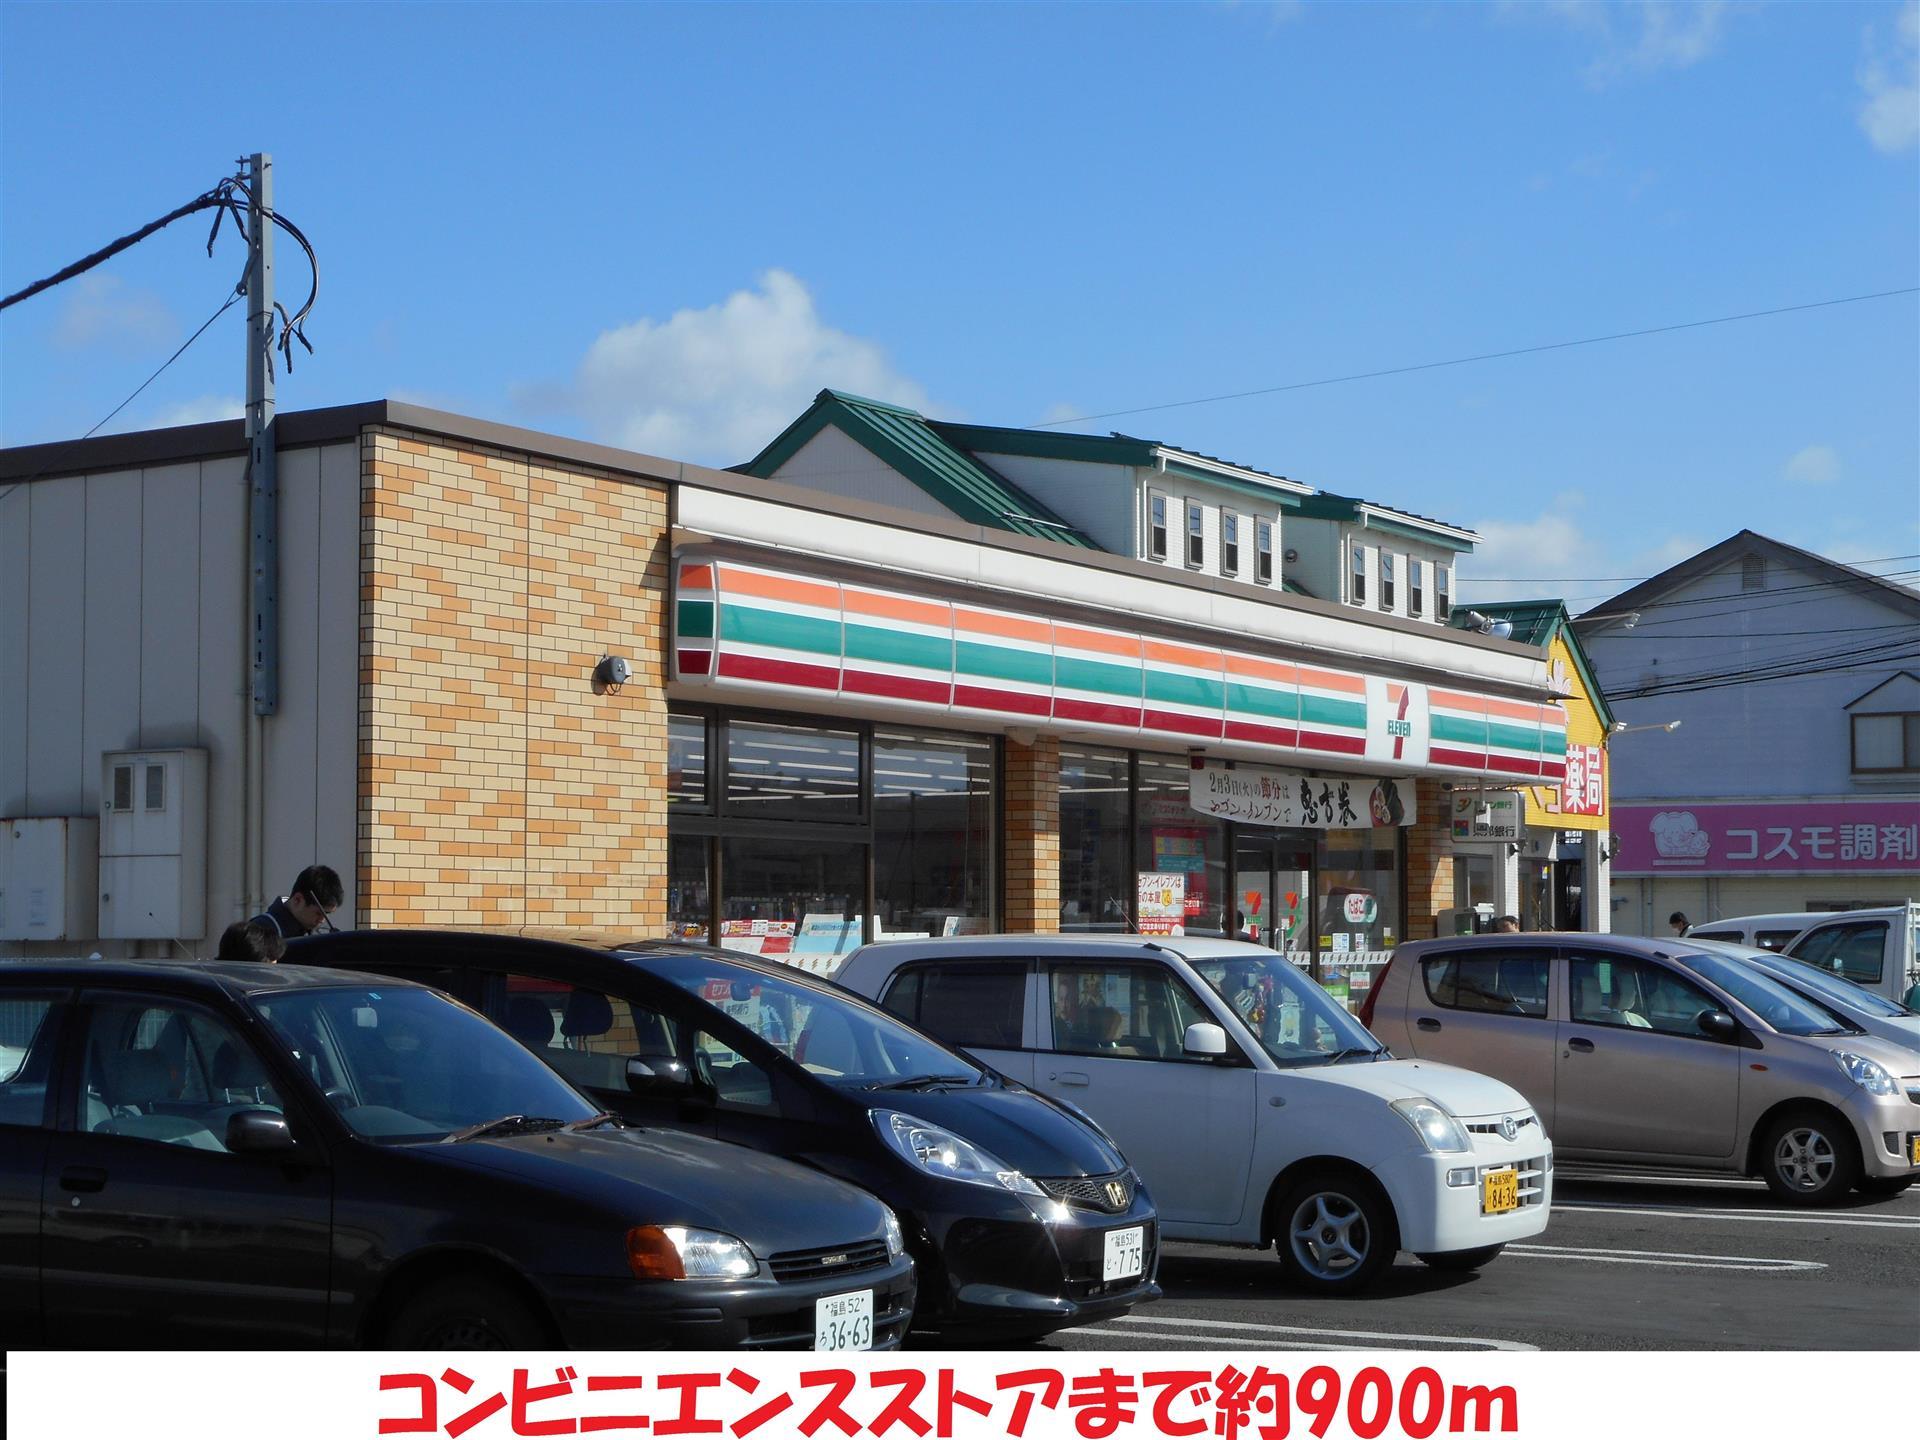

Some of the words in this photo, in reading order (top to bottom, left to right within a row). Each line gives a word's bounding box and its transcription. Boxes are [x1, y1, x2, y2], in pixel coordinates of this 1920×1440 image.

[1564, 744, 1603, 816] 薬局
[1300, 778, 1358, 827] 恵方巻
[1726, 824, 1918, 861] コスモ調剤
[829, 1315, 870, 1351] 36-63
